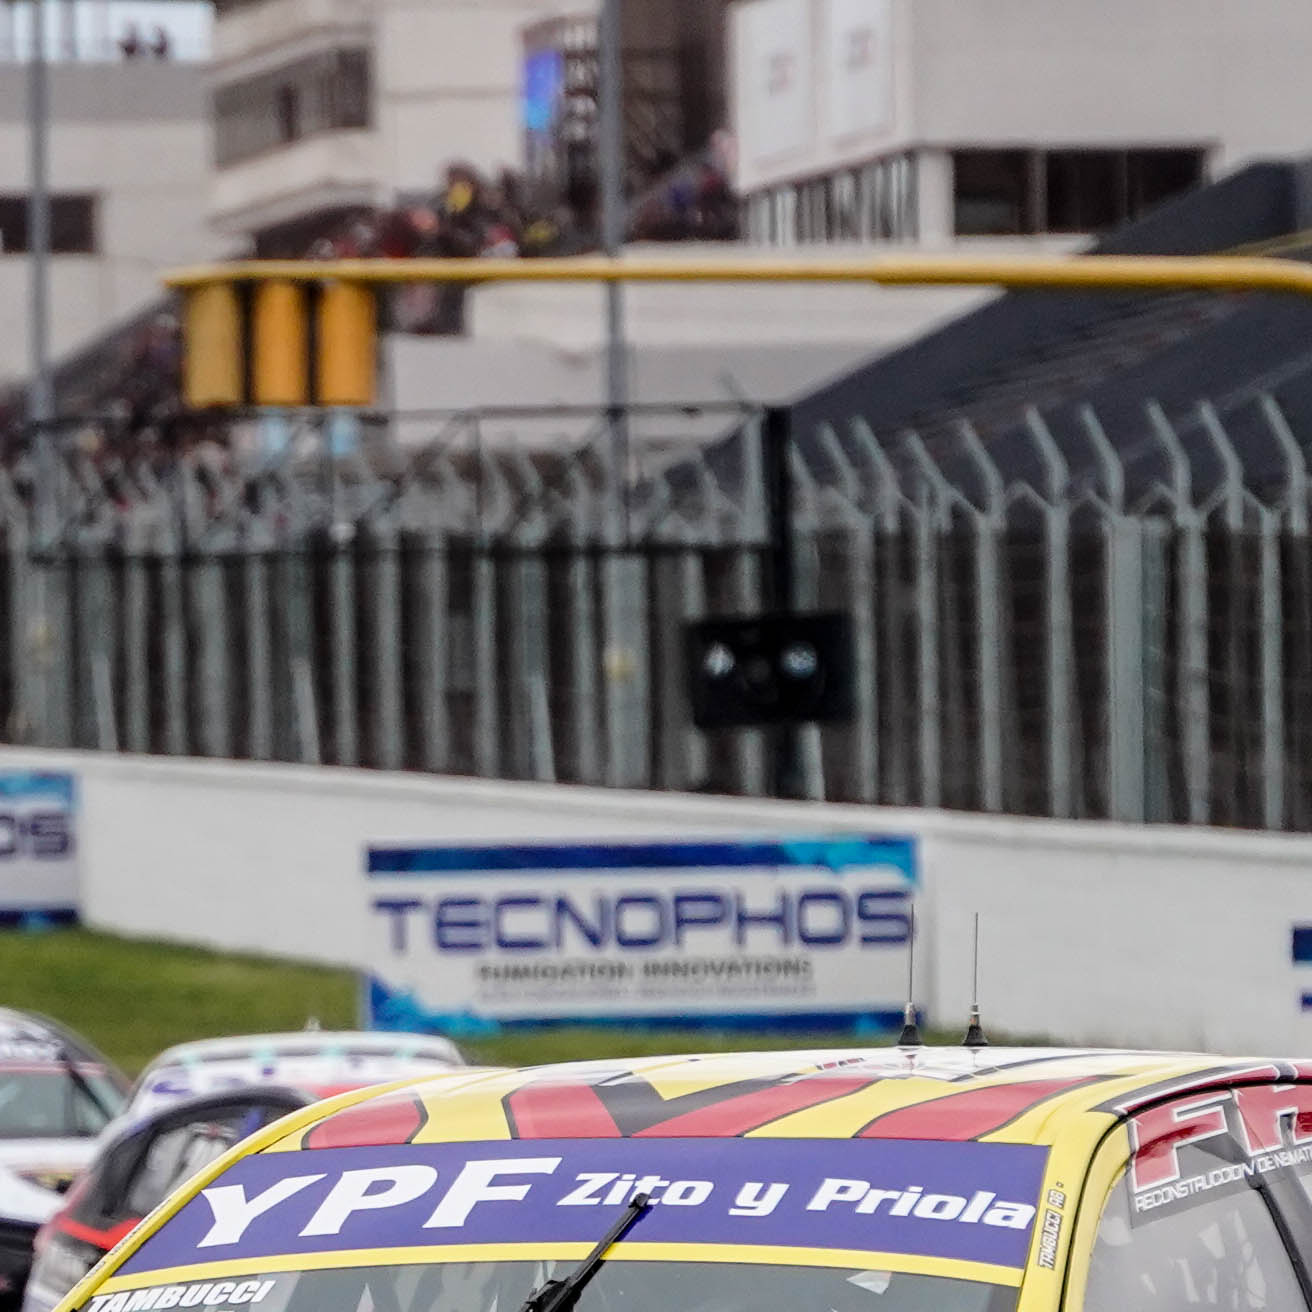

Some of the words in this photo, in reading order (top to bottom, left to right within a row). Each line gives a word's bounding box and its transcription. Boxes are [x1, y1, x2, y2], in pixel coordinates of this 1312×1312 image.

[372, 890, 913, 953] TECNOPHOS
[196, 1157, 563, 1249] YPF
[557, 1173, 715, 1206] Zito
[728, 1181, 789, 1217] y
[805, 1178, 1036, 1230] Priola
